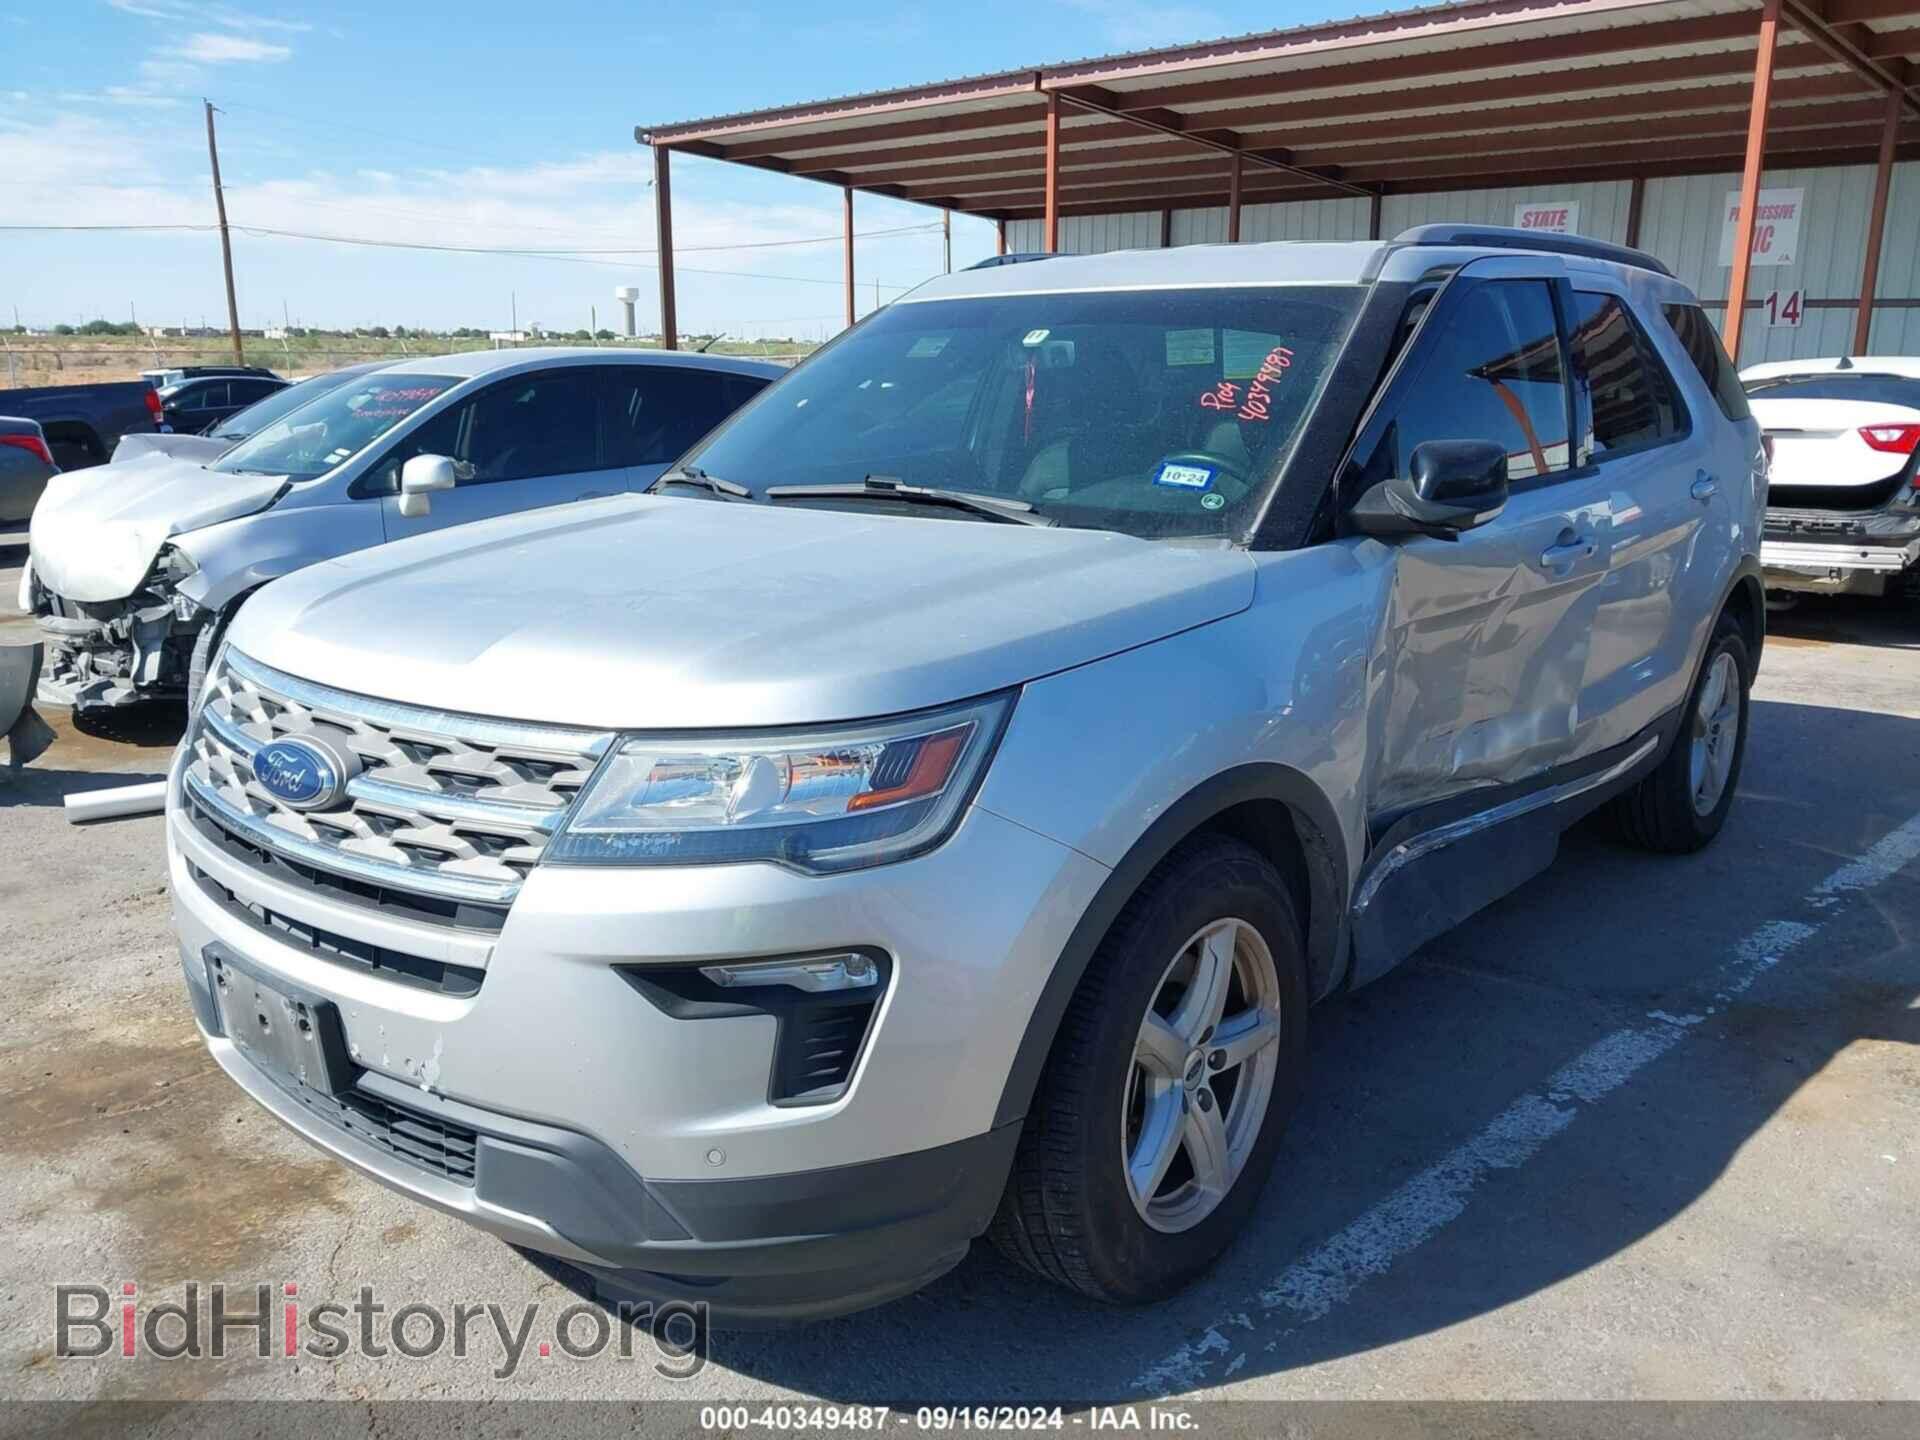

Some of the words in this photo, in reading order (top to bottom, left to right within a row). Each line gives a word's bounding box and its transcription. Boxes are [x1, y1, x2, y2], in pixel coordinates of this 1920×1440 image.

[1521, 209, 1568, 228] STATE
[1766, 290, 1800, 325] 14
[1238, 347, 1294, 420] 40349487
[261, 750, 307, 792] Ford
